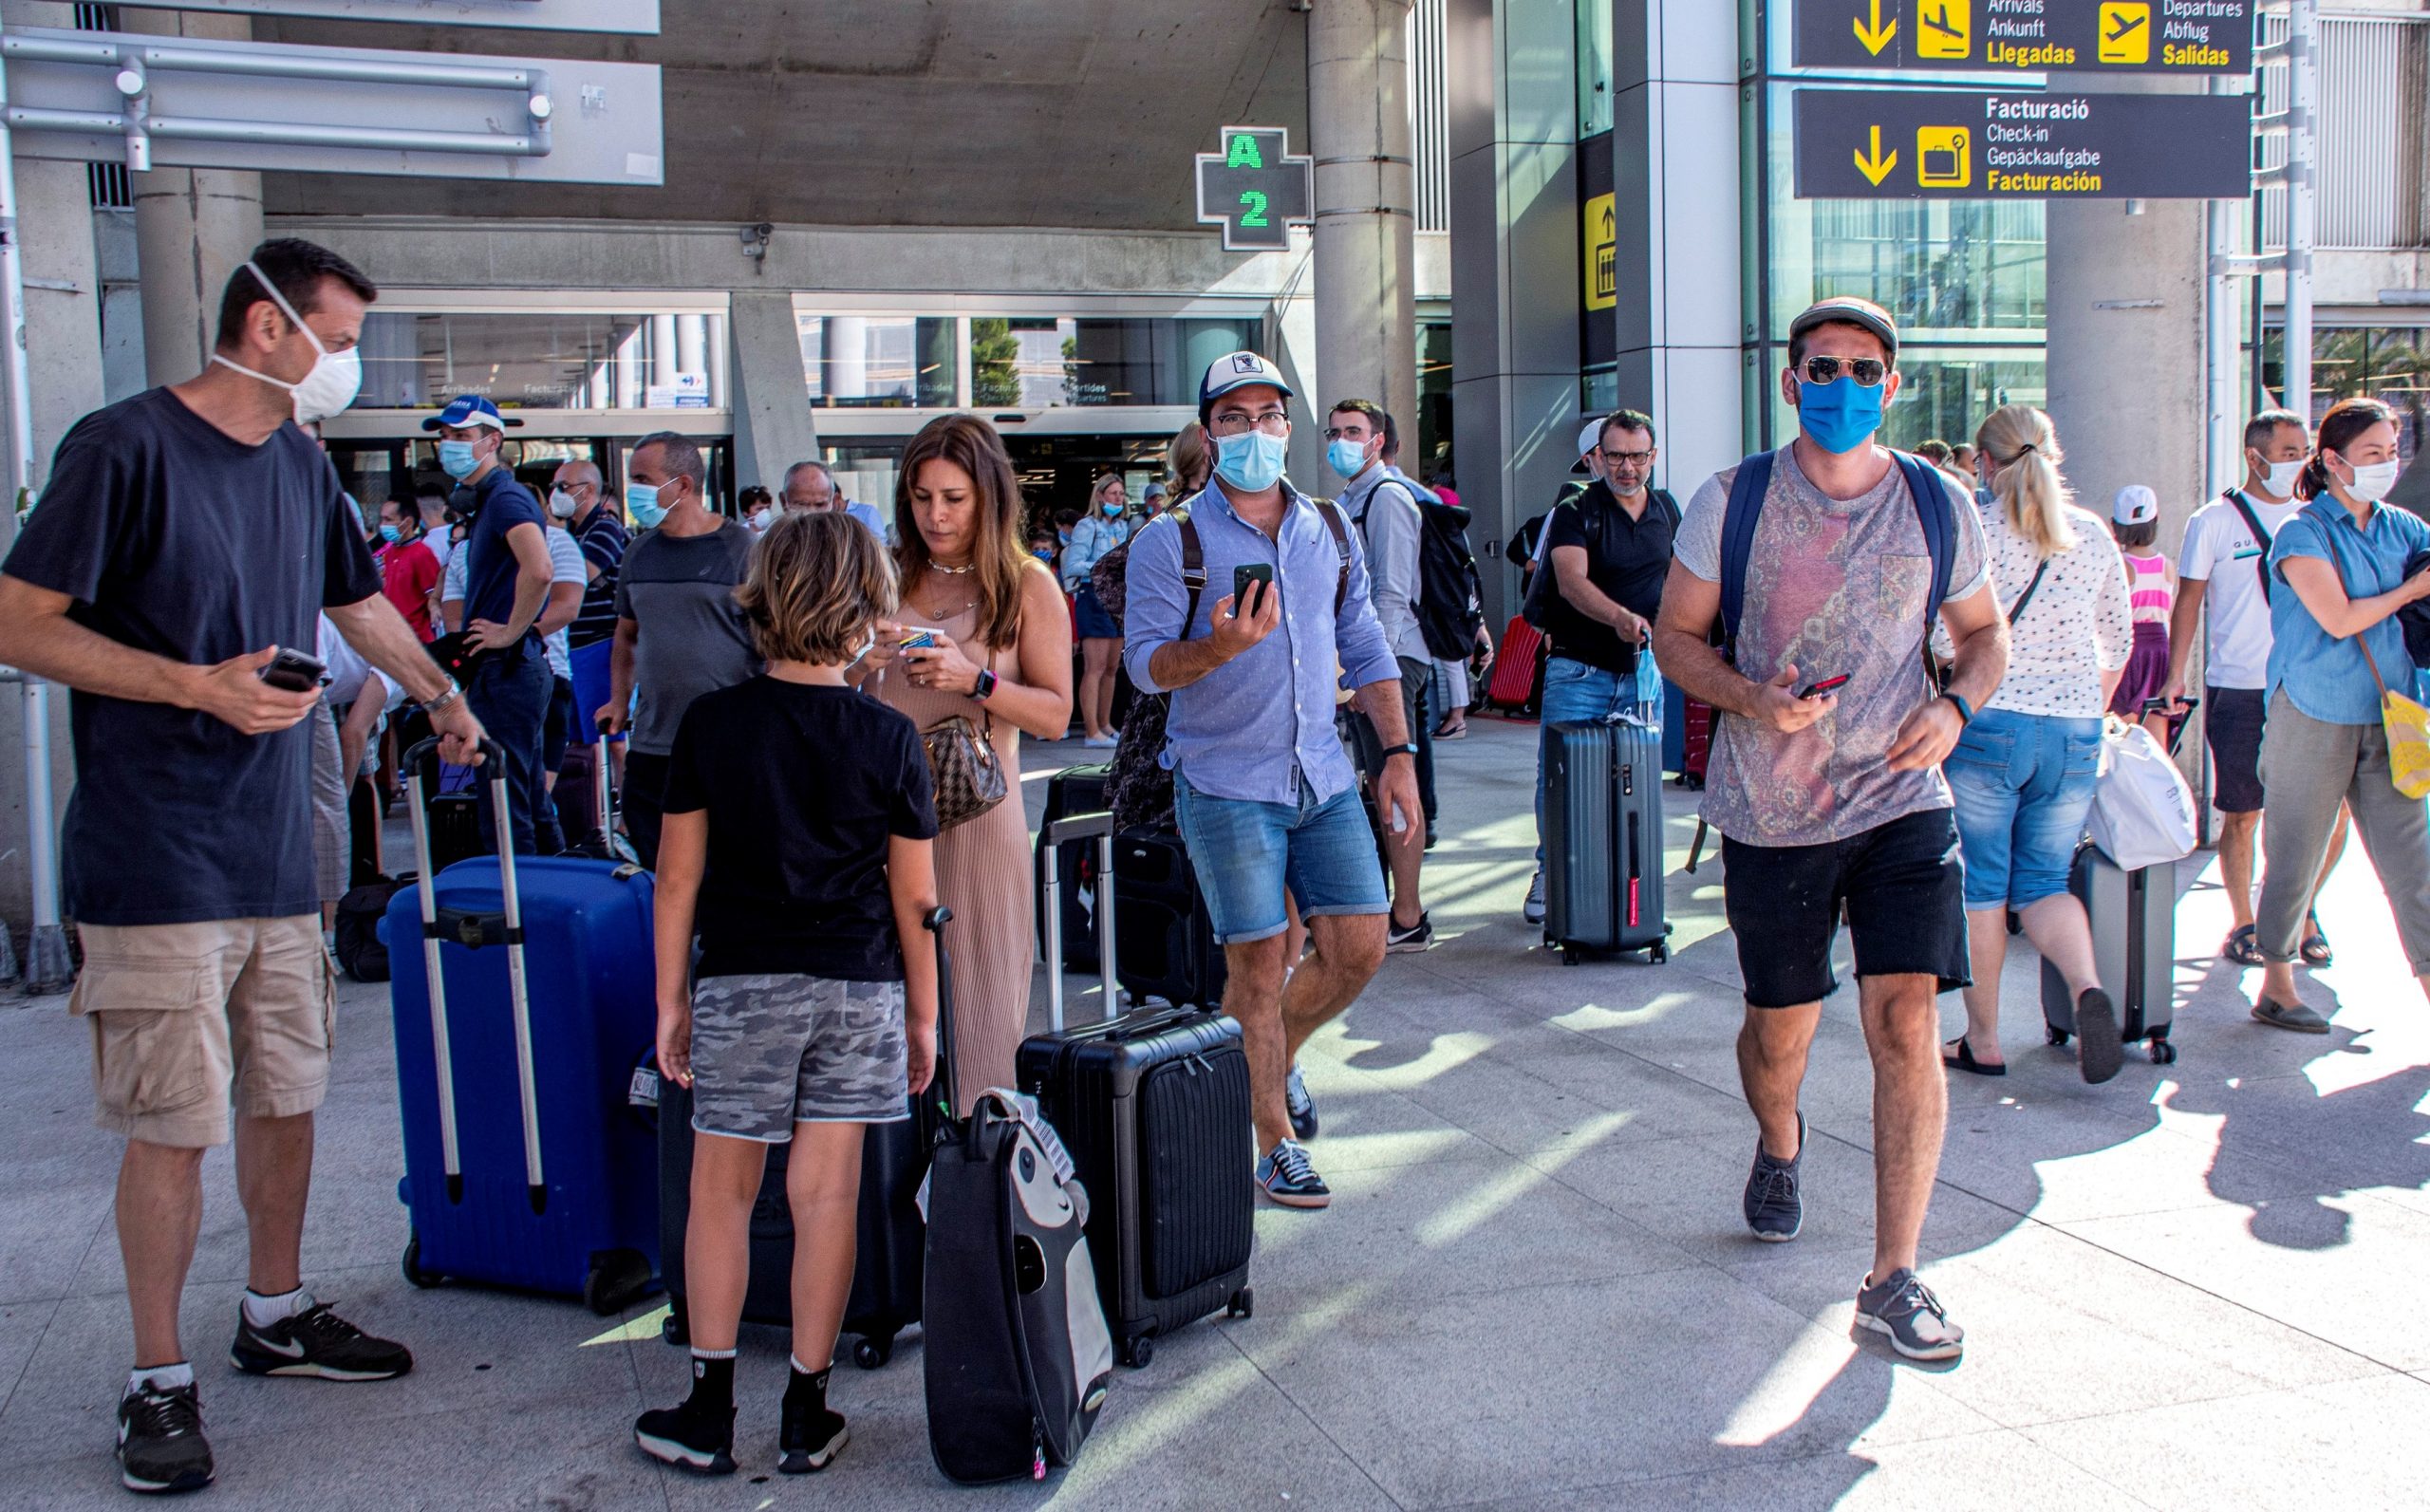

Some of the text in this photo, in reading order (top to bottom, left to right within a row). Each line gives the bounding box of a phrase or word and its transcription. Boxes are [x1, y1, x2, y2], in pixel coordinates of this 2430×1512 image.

[1988, 0, 2044, 13] Arrivals
[2163, 0, 2243, 17] Departures
[1988, 18, 2046, 37] Ankunft
[2163, 21, 2209, 43] Abflug
[1987, 42, 2076, 67] Llegadas
[2162, 44, 2230, 65] Salidas
[1986, 98, 2089, 120] Facturació
[1987, 124, 2049, 142] Check-in
[1227, 135, 1262, 168] A
[1987, 147, 2101, 169] Gepäckaufgabe
[1988, 170, 2102, 191] Facturación
[1240, 191, 1268, 227] 2
